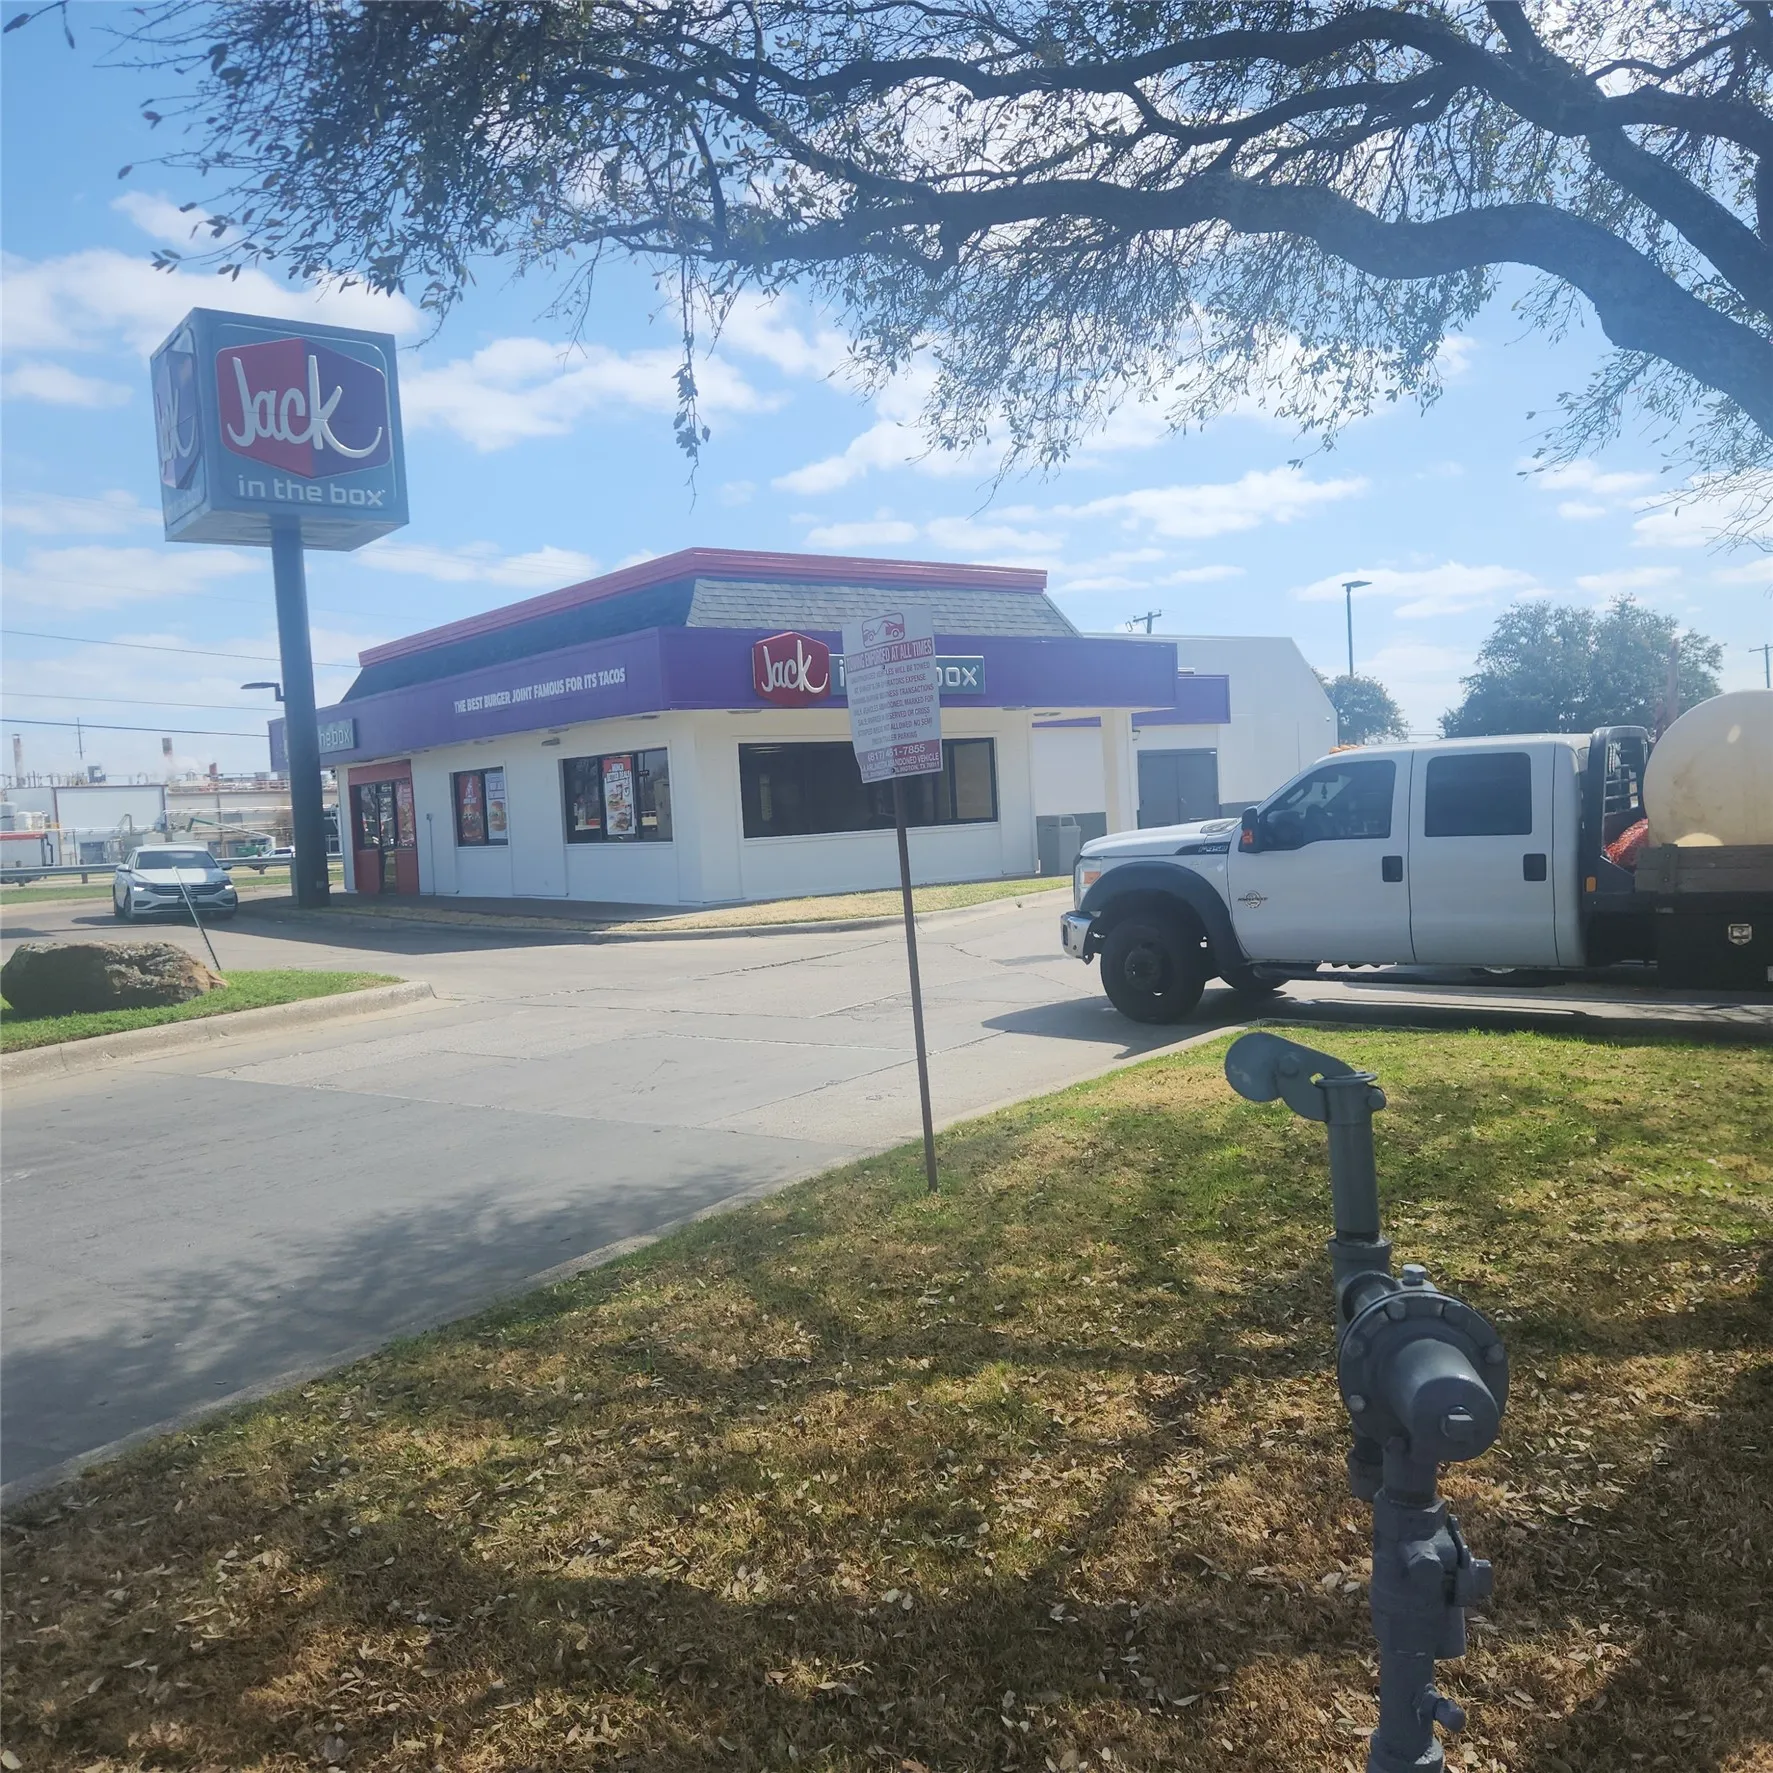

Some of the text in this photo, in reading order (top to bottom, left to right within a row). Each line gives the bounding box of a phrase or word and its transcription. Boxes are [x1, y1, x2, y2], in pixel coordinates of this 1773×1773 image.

[227, 354, 382, 459] Jack
[238, 475, 384, 508] in the box
[891, 645, 899, 661] AT
[900, 642, 912, 659] ALL
[912, 639, 932, 656] TIMES
[761, 639, 828, 693] Jack
[454, 667, 626, 713] THE BEST BURGER JOINT FAMOUS FOR ITS TACOS
[900, 683, 934, 695] TRANSACTIONS
[924, 695, 934, 703] FOR
[332, 728, 351, 745] box
